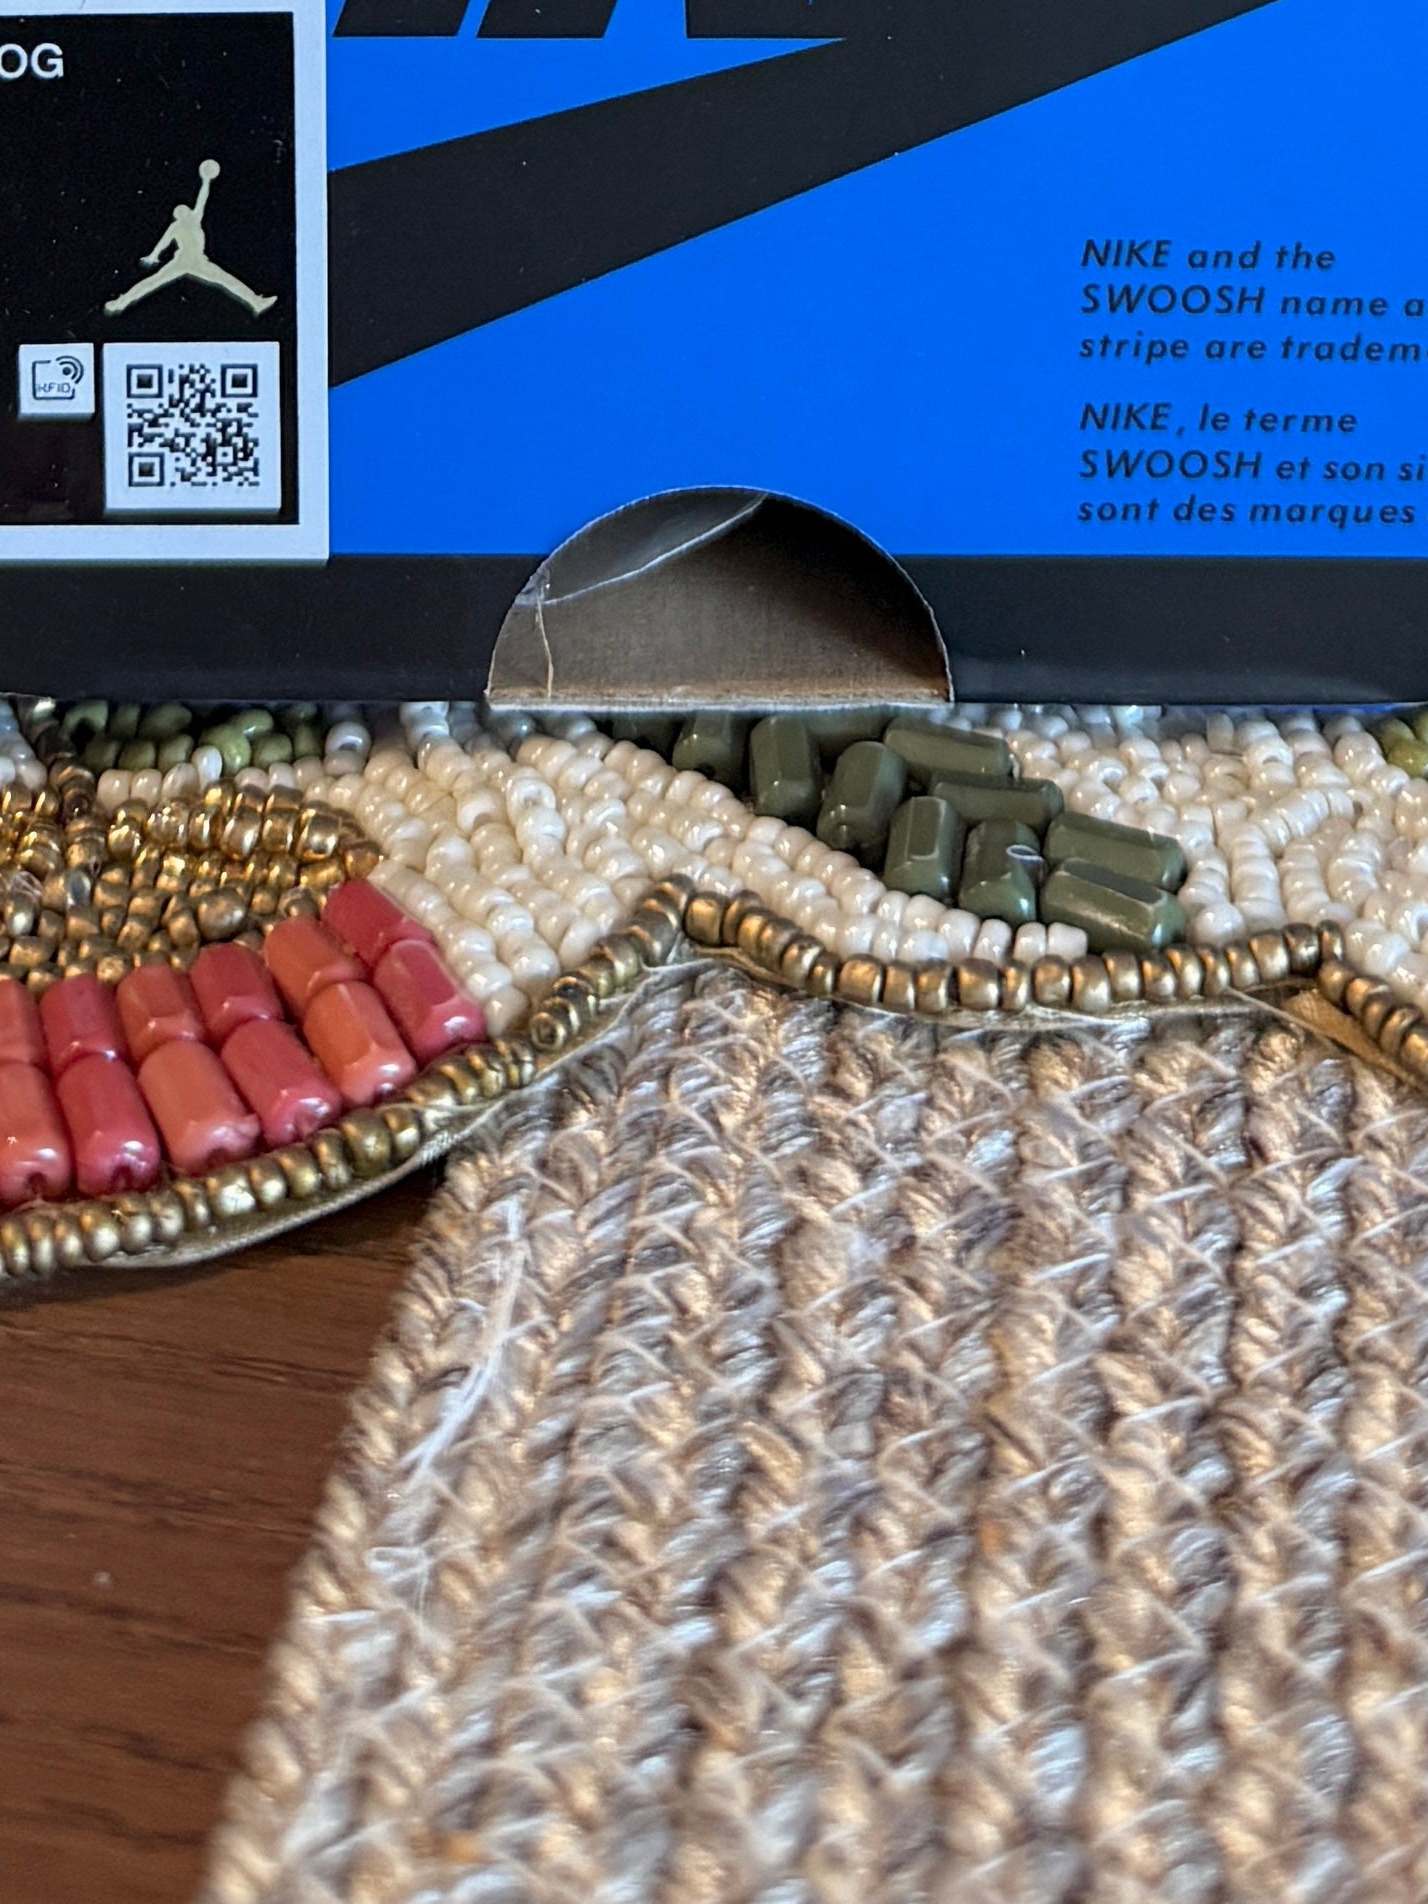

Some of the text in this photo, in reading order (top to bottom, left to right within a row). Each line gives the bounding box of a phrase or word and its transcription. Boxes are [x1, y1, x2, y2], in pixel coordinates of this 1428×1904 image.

[1080, 238, 1336, 272] NIKE and the
[1080, 282, 1266, 315] SWOOSH
[1280, 296, 1389, 318] name
[1078, 329, 1190, 367] stripe
[1204, 339, 1268, 361] are
[35, 382, 71, 394] RFID
[1079, 402, 1358, 438] NIKE, le terme
[1079, 448, 1263, 481] SWOOSH
[1275, 456, 1311, 481] et
[1322, 460, 1386, 482] son
[1077, 497, 1160, 524] sont
[1172, 493, 1237, 525] des
[1249, 503, 1416, 531] marques
